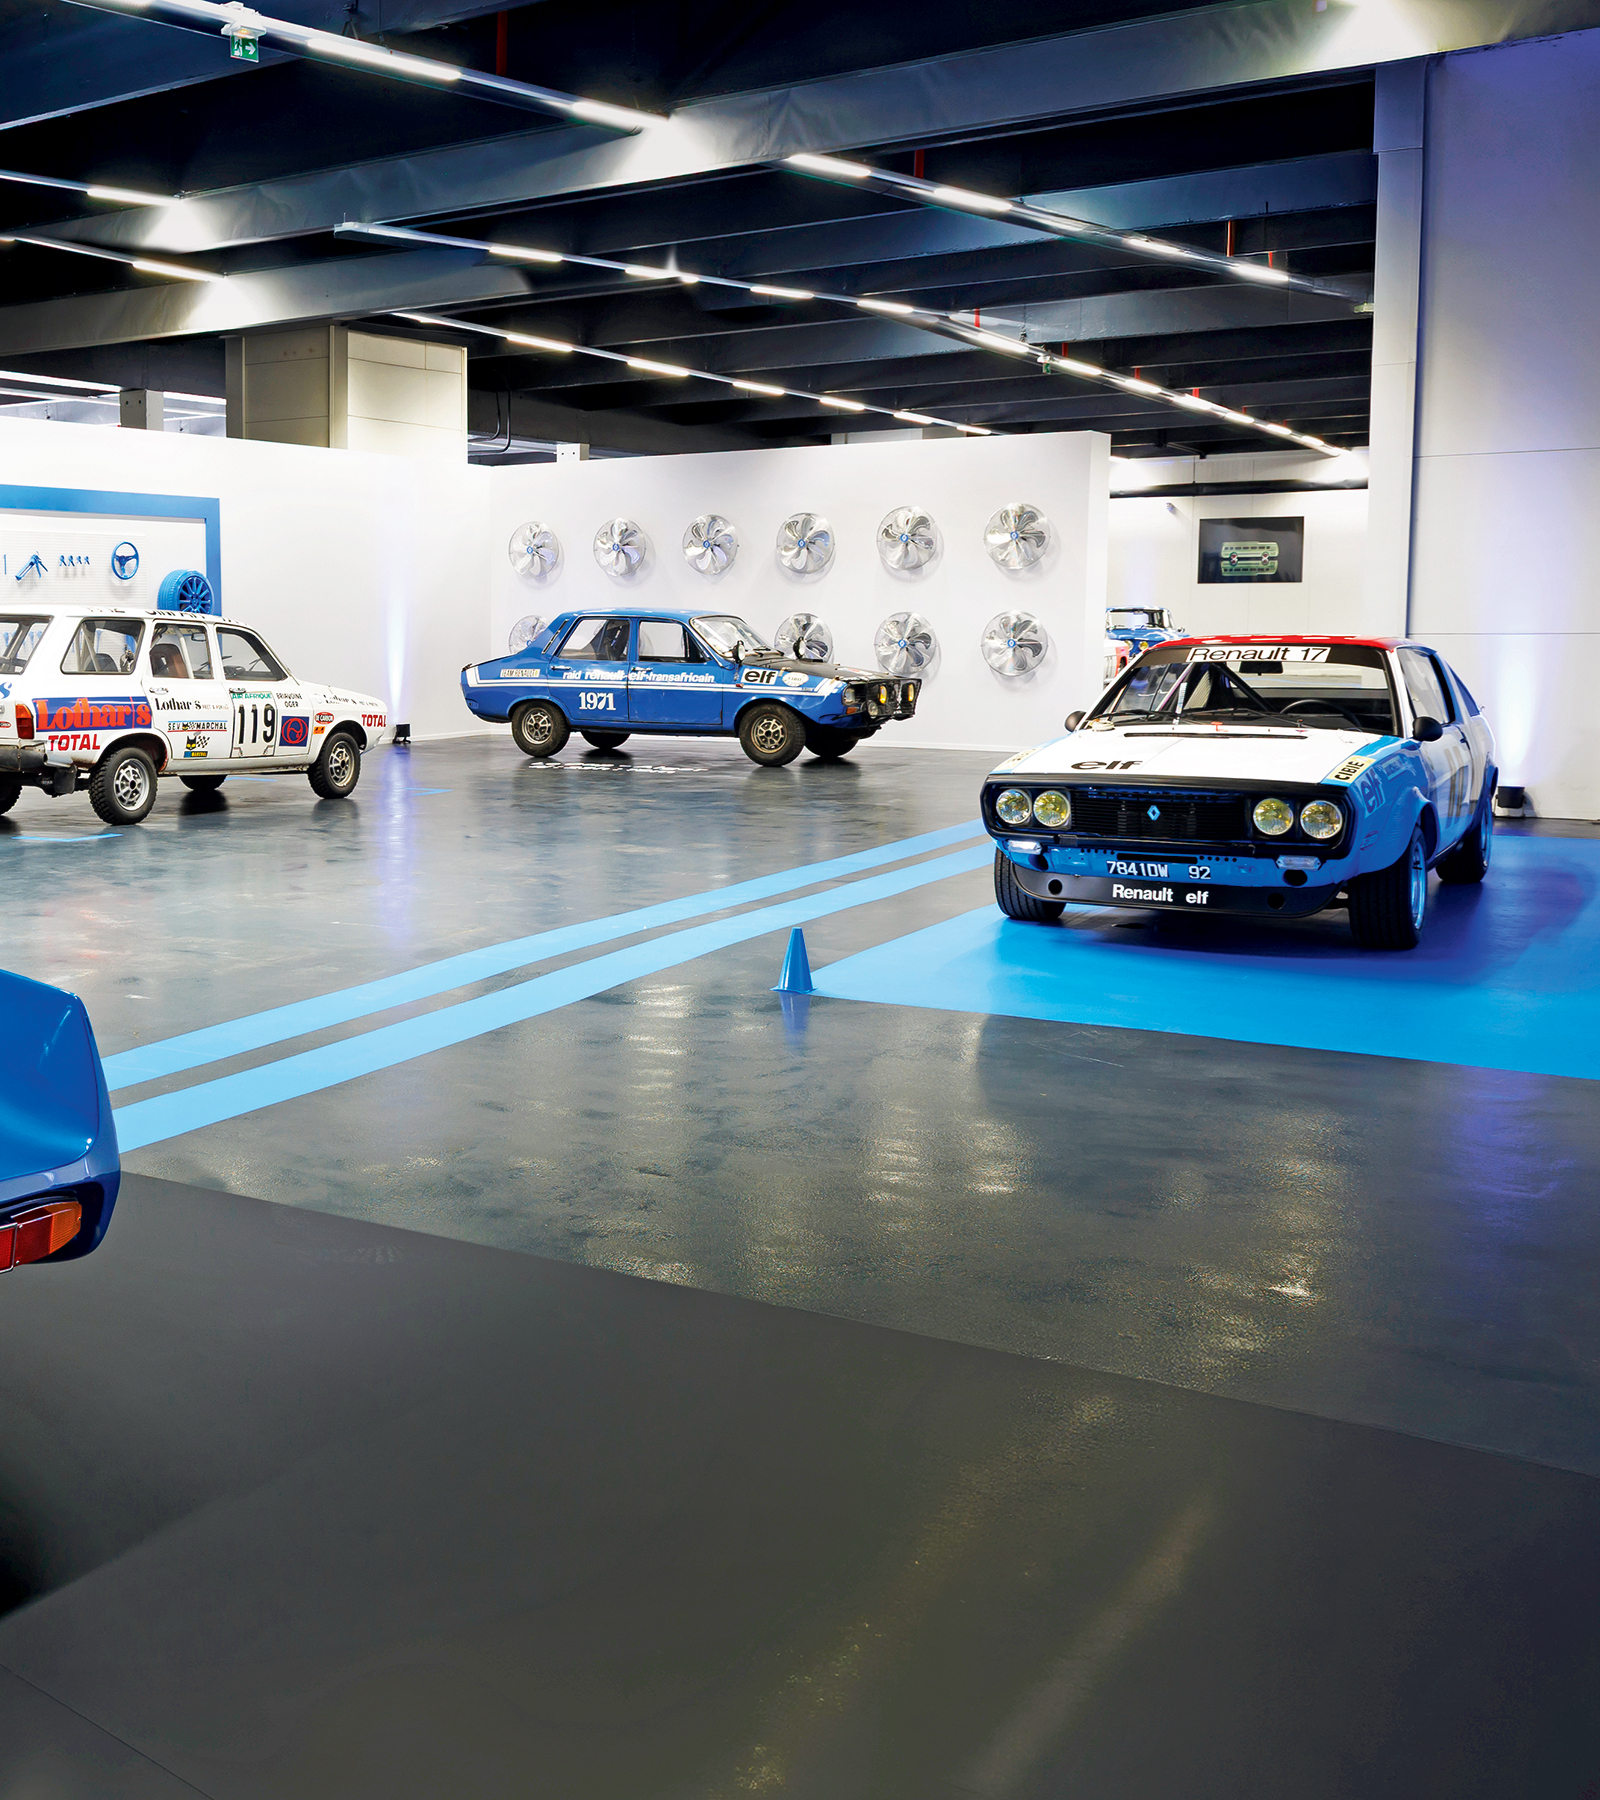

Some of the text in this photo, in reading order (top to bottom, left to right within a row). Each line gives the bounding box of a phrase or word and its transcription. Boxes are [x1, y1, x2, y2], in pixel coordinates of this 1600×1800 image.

[1190, 647, 1327, 661] Renault 17
[563, 670, 582, 680] raid
[744, 670, 776, 683] elf
[231, 692, 273, 700] AIR AFRIQUE
[578, 691, 617, 710] 1971
[167, 721, 228, 731] SEV MARCHAL
[237, 703, 276, 744] 119
[361, 714, 387, 728] TOTAL
[48, 733, 101, 752] TOTAL
[1070, 760, 1143, 770] elf
[1334, 759, 1365, 782] CIBIE
[1361, 769, 1385, 814] elf
[1188, 865, 1212, 880] 92
[1112, 883, 1209, 905] Renault elf
